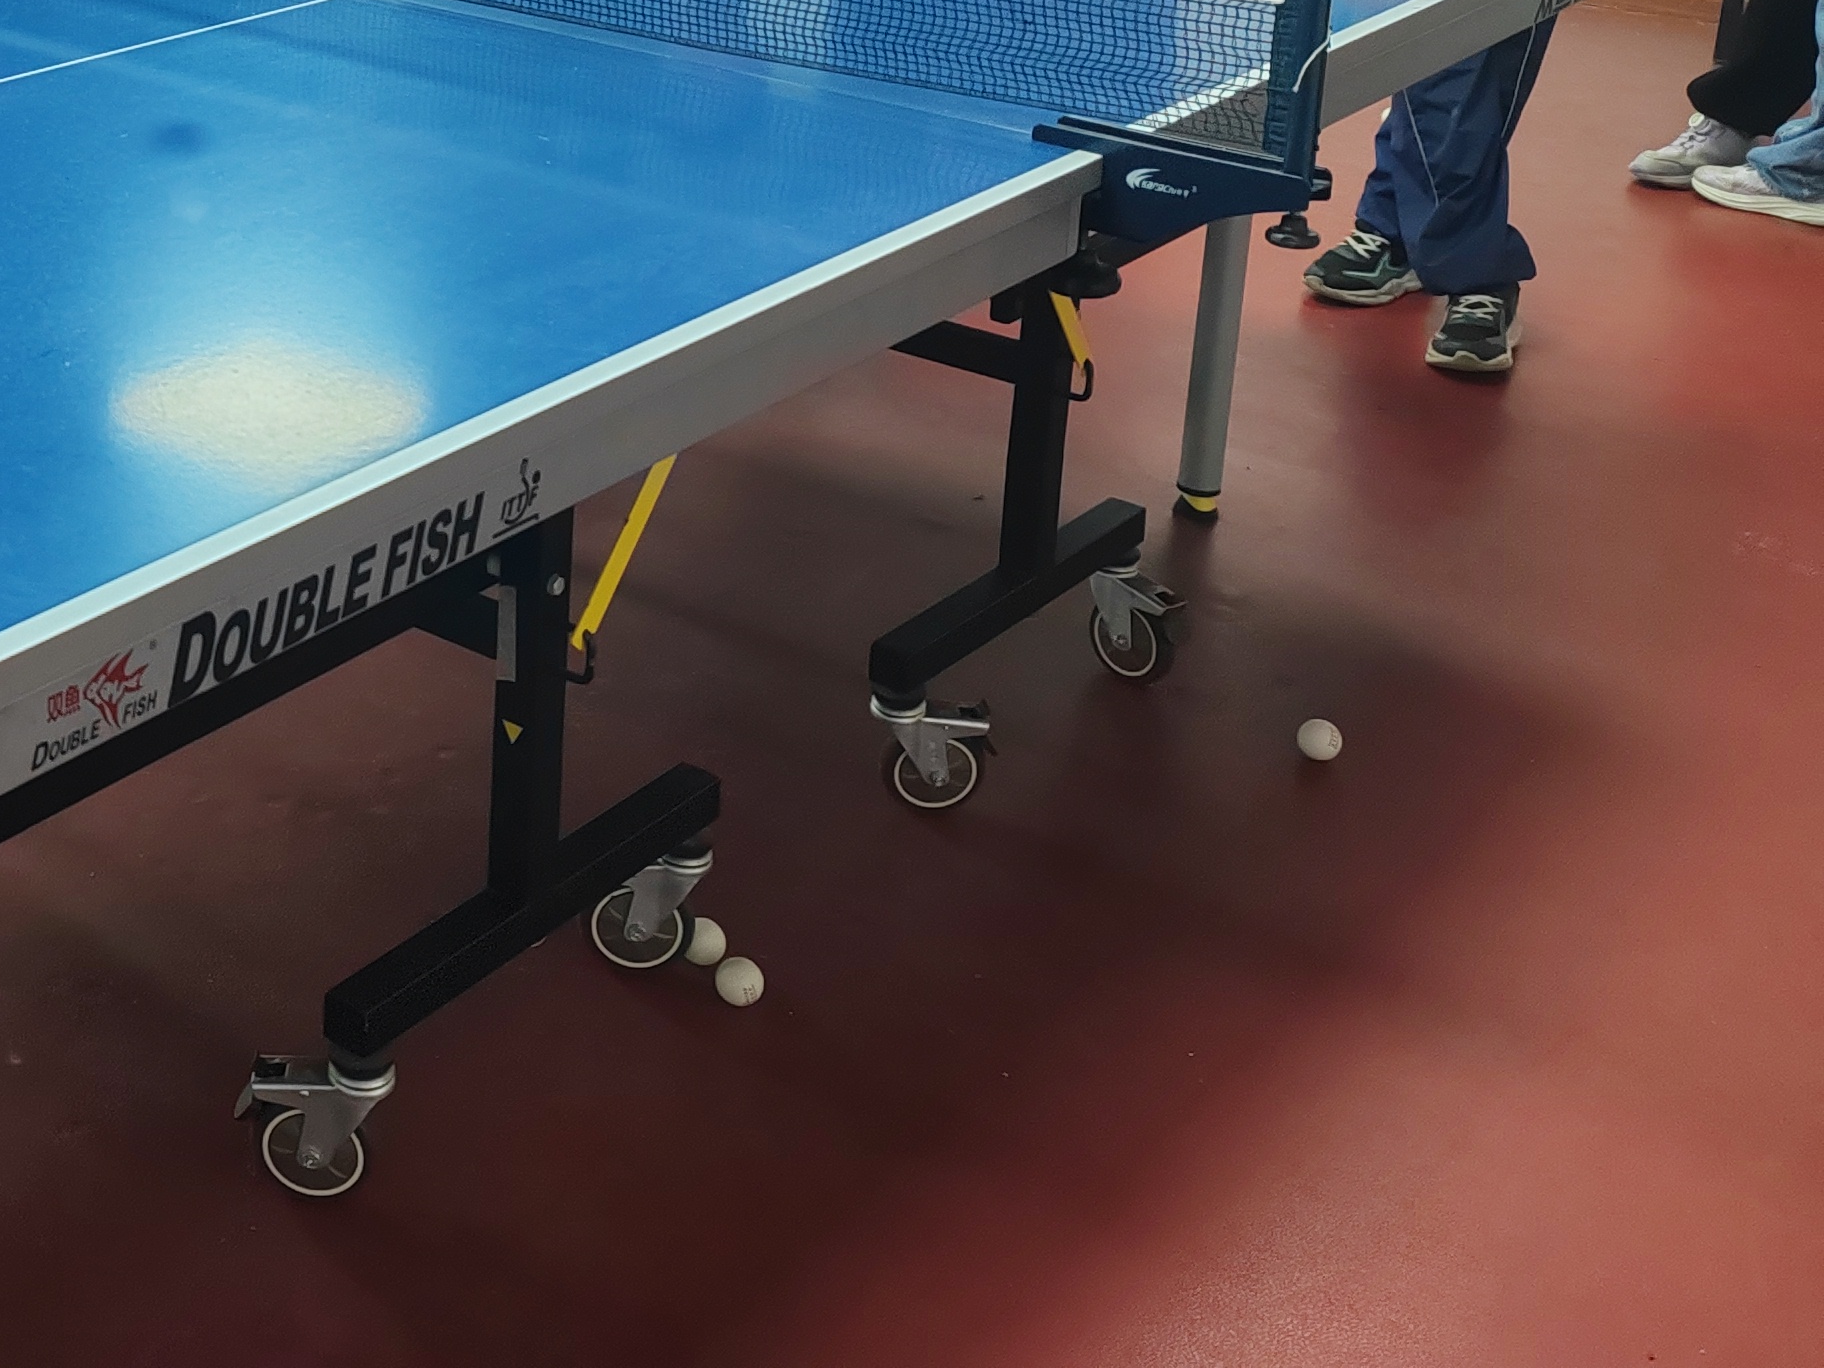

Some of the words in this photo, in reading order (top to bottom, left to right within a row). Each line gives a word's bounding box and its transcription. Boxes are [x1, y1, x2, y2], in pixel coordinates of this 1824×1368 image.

[167, 543, 378, 708] DOUBLE
[381, 490, 486, 599] FISH
[31, 718, 103, 772] DOUBLE
[121, 689, 158, 724] FISH
[46, 684, 81, 724] 双鱼
